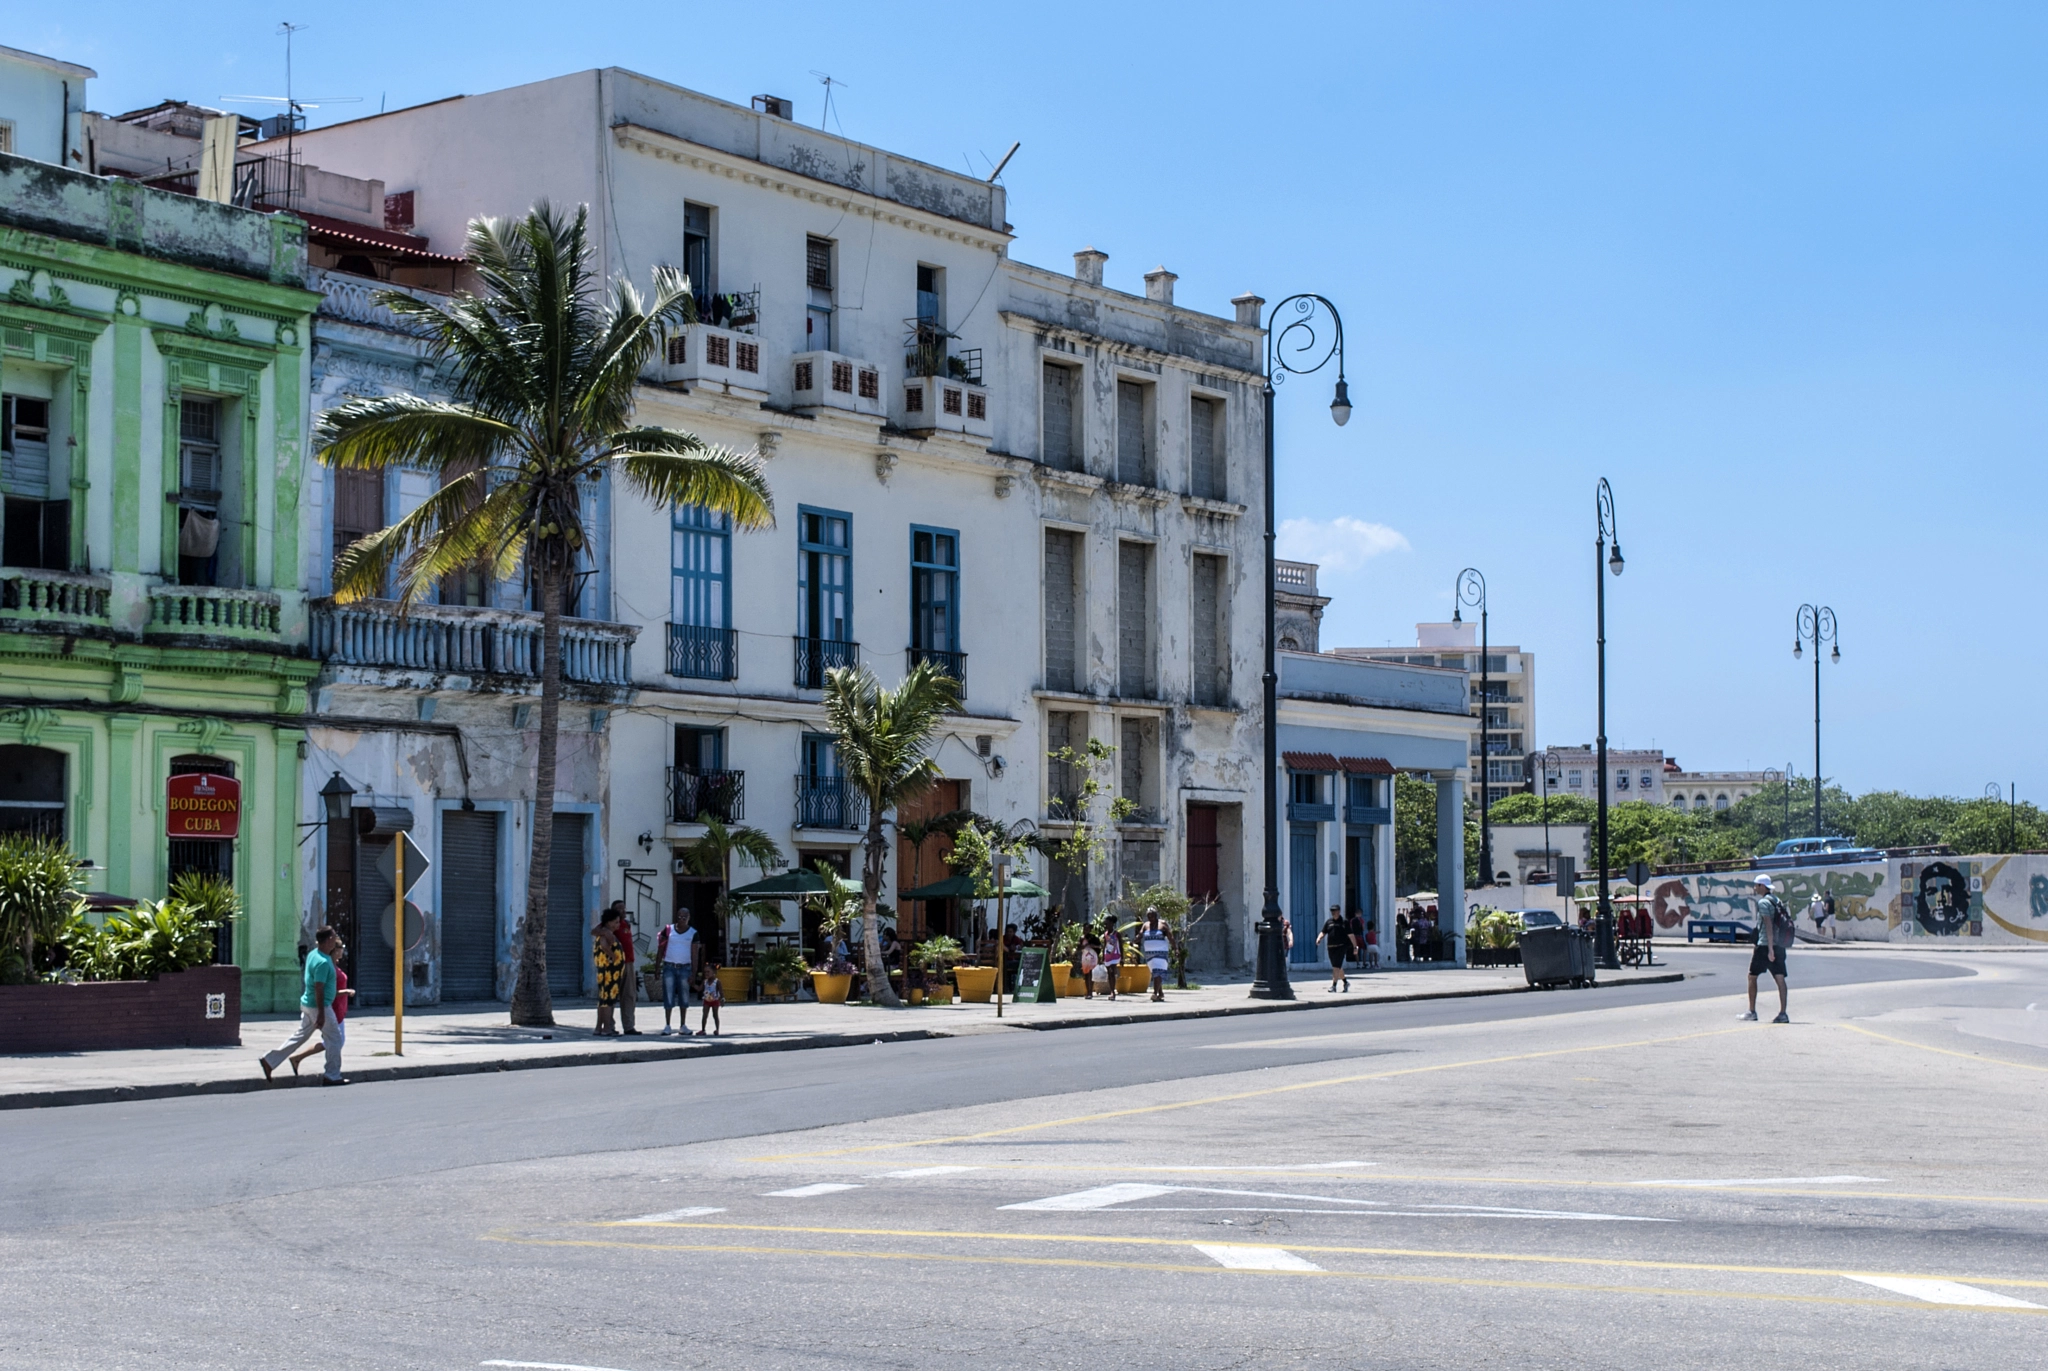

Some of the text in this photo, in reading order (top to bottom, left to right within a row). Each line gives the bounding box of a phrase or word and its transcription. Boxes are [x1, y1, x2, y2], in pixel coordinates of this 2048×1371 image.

[170, 798, 237, 811] BODEGON
[185, 818, 220, 830] CUBA
[777, 858, 789, 867] bar
